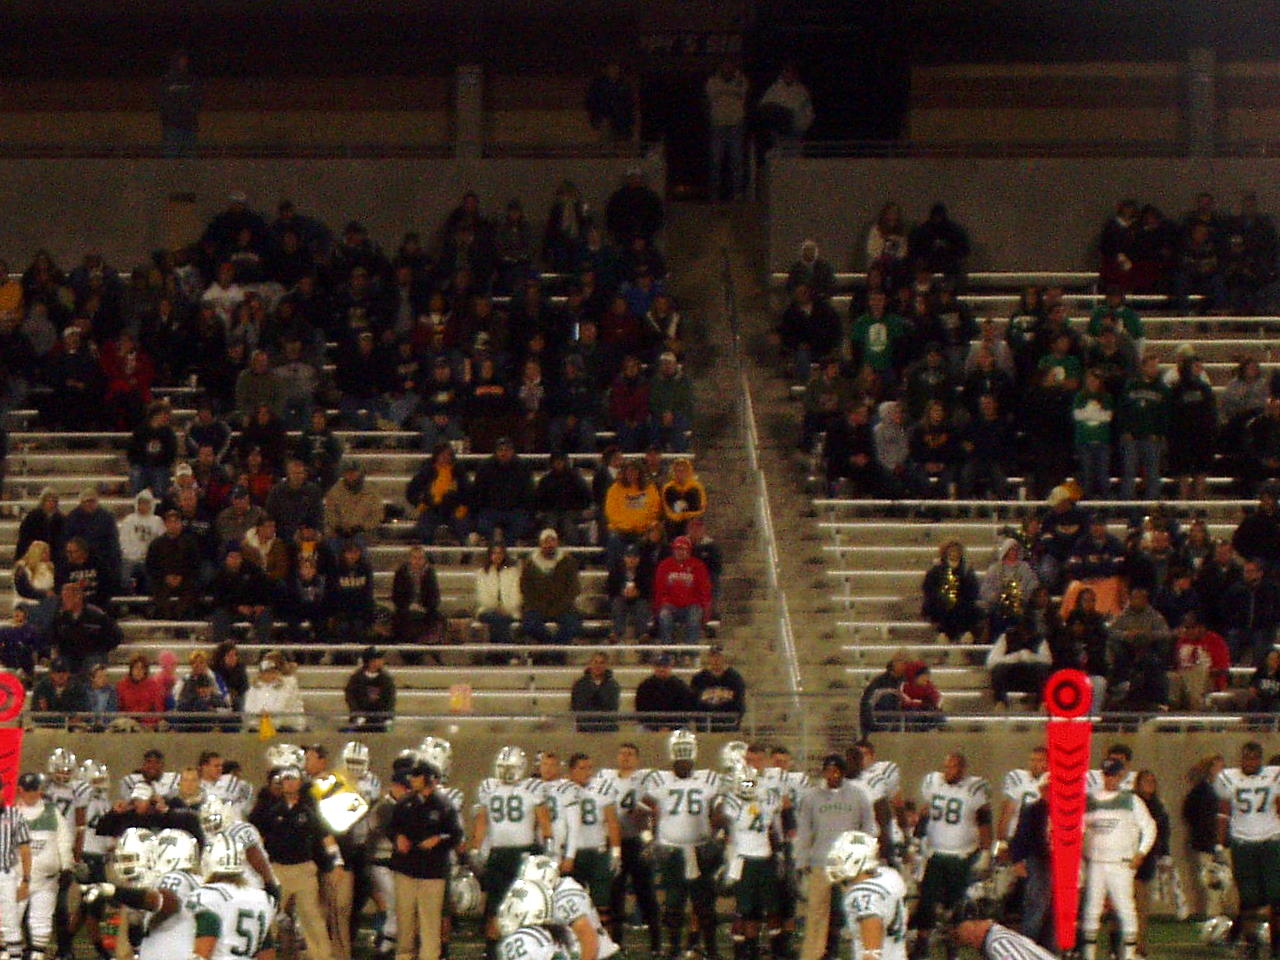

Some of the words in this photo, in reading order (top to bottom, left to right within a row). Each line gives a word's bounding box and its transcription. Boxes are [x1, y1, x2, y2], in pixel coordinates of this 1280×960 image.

[489, 795, 524, 823] 98
[668, 788, 703, 816] 76
[931, 796, 964, 824] 58
[1235, 786, 1270, 814] 57
[230, 908, 268, 957] 51
